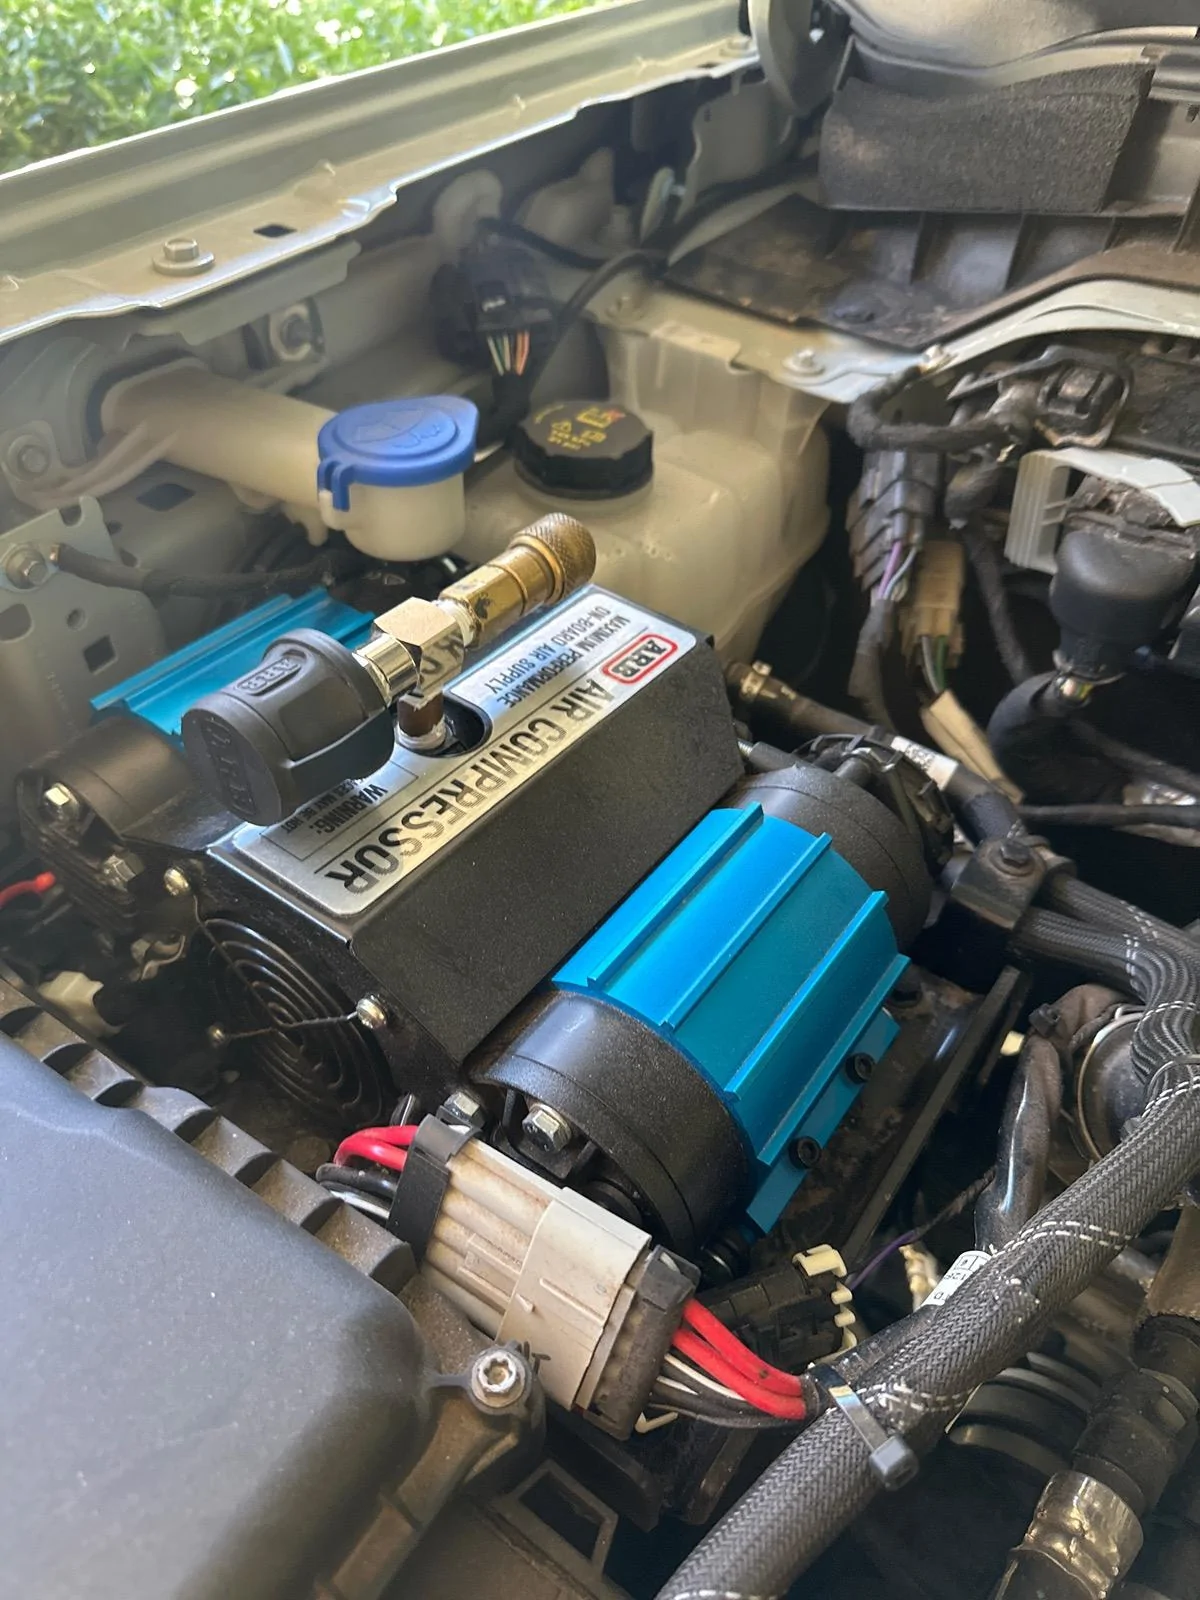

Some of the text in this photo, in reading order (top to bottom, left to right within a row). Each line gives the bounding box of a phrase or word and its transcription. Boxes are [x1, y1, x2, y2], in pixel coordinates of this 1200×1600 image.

[484, 606, 611, 694] ON-BOARD AIR SUPPLY
[575, 615, 631, 652] MAXIMUM
[610, 638, 668, 678] ARB
[497, 648, 584, 708] PERFORMANCE
[550, 679, 615, 722] AIR
[309, 784, 388, 834] WARNING:
[324, 717, 567, 894] COMPRESSOR
